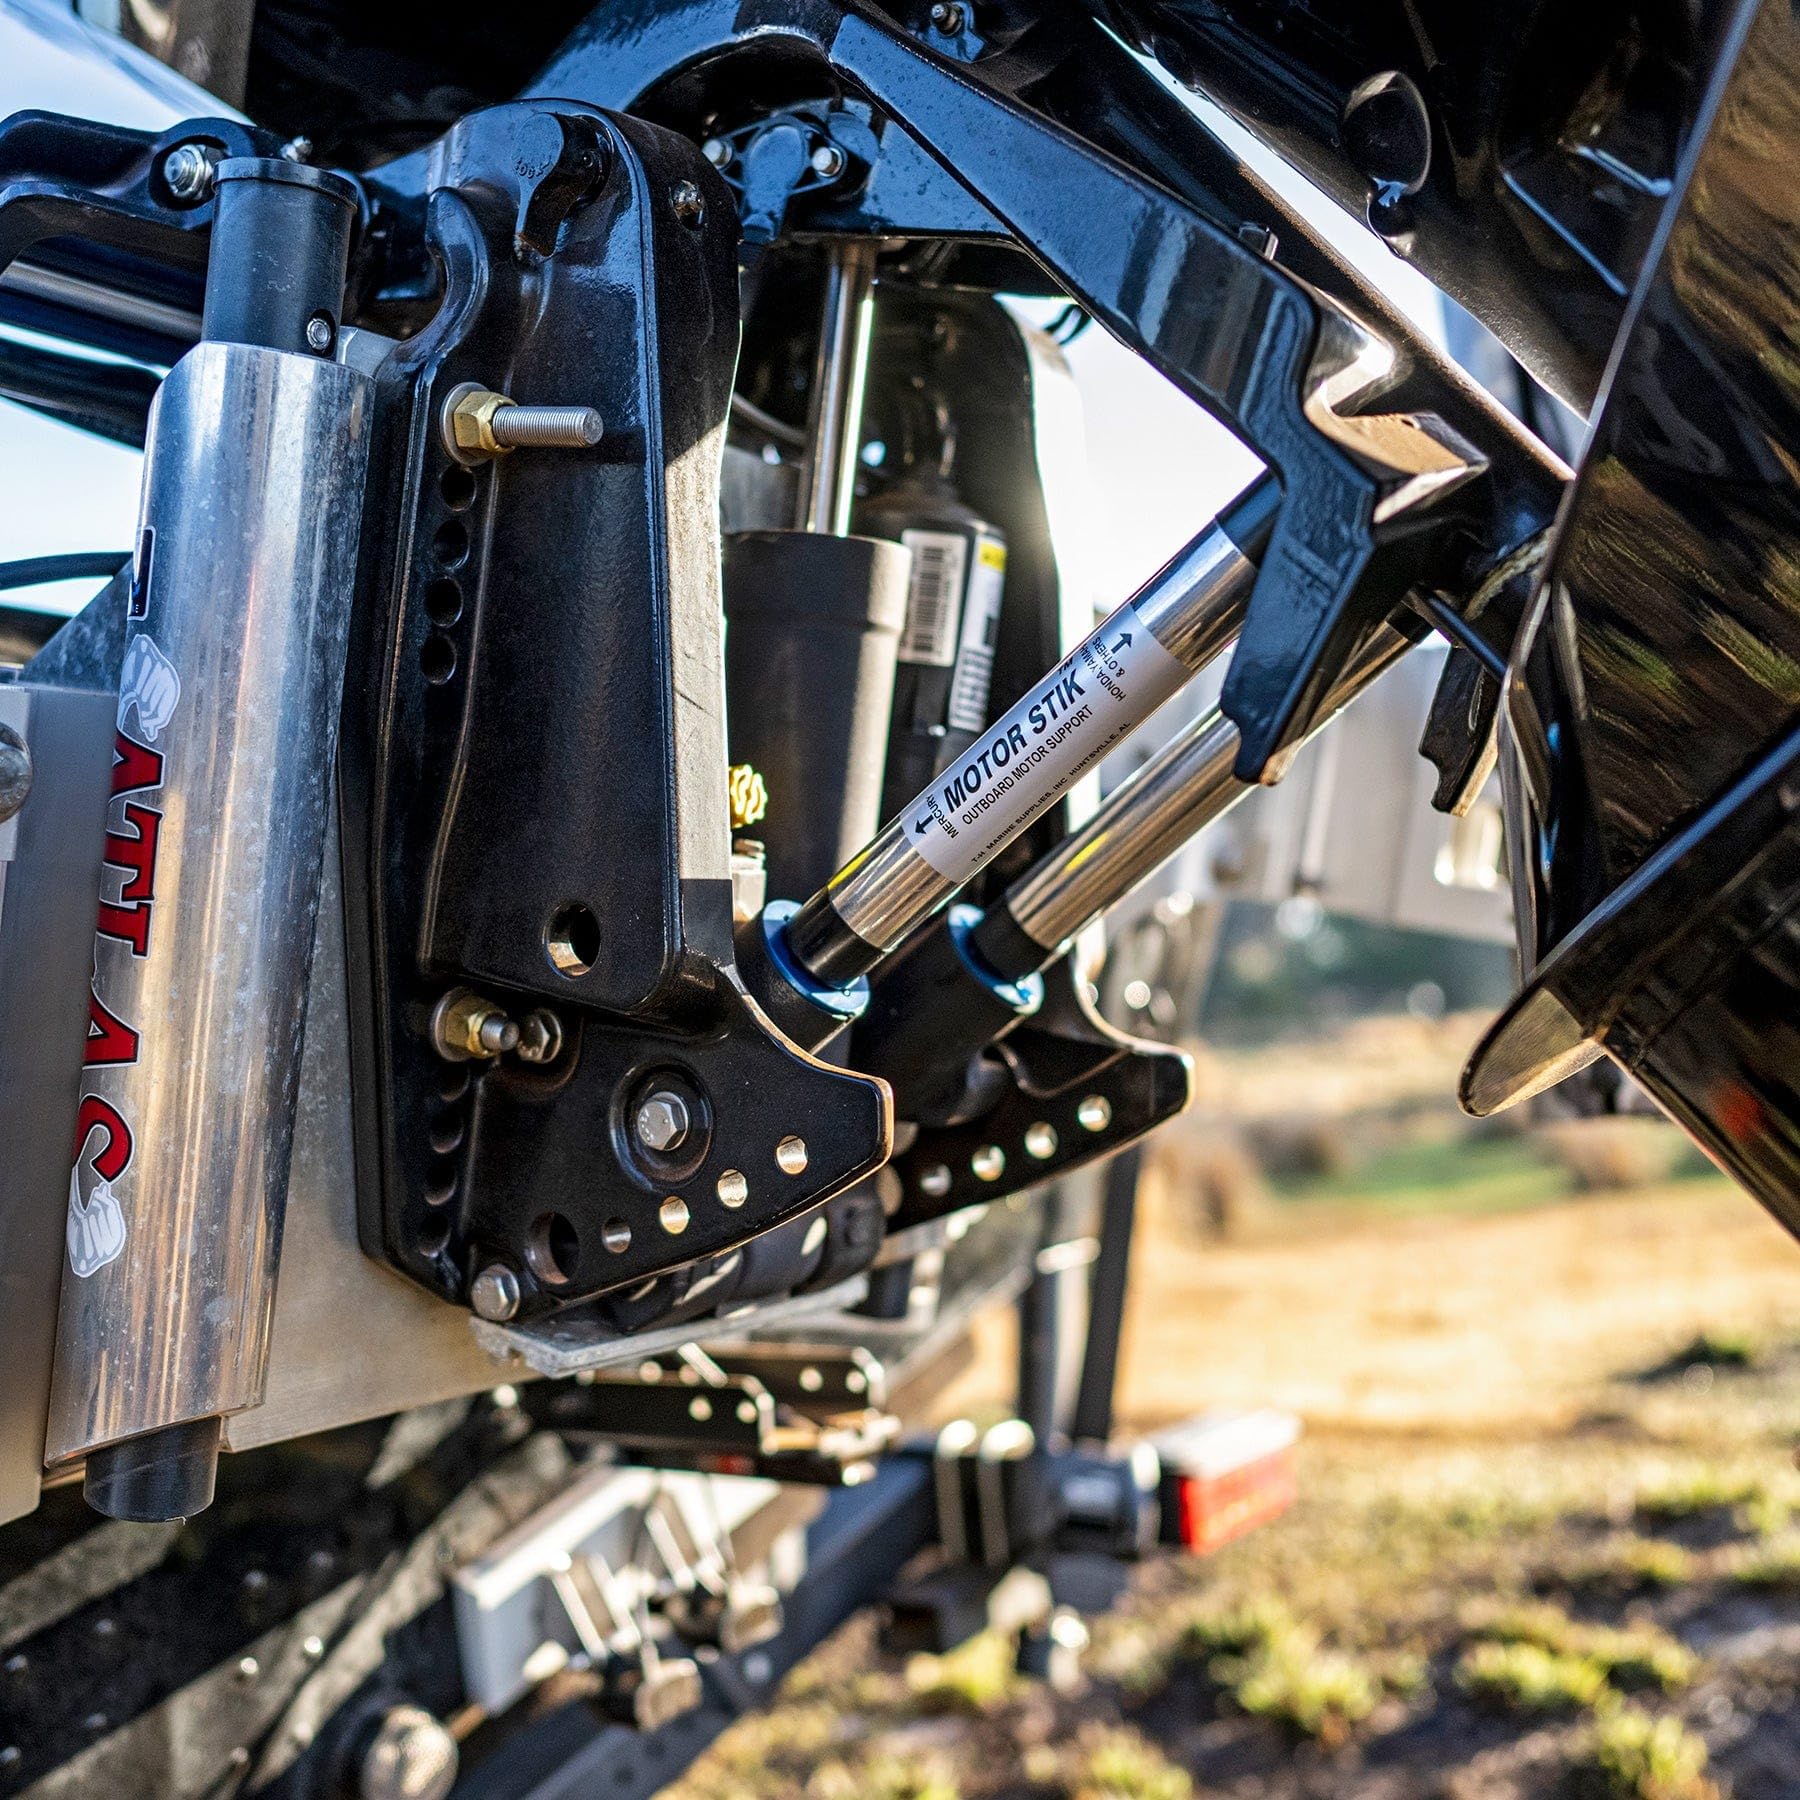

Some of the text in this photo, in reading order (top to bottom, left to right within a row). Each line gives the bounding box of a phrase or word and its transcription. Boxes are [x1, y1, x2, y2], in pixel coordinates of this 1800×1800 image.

[1080, 643, 1127, 702] HONDA, YAMAH
[1092, 636, 1126, 678] & OTHERS
[943, 723, 1028, 814] MOTOR
[1028, 668, 1086, 735] STIK
[962, 704, 1093, 825] OUTBOARD MOTOR SUPPORT
[986, 824, 1016, 850] MARINE
[1118, 721, 1131, 732] AL
[926, 794, 959, 839] MERCURY
